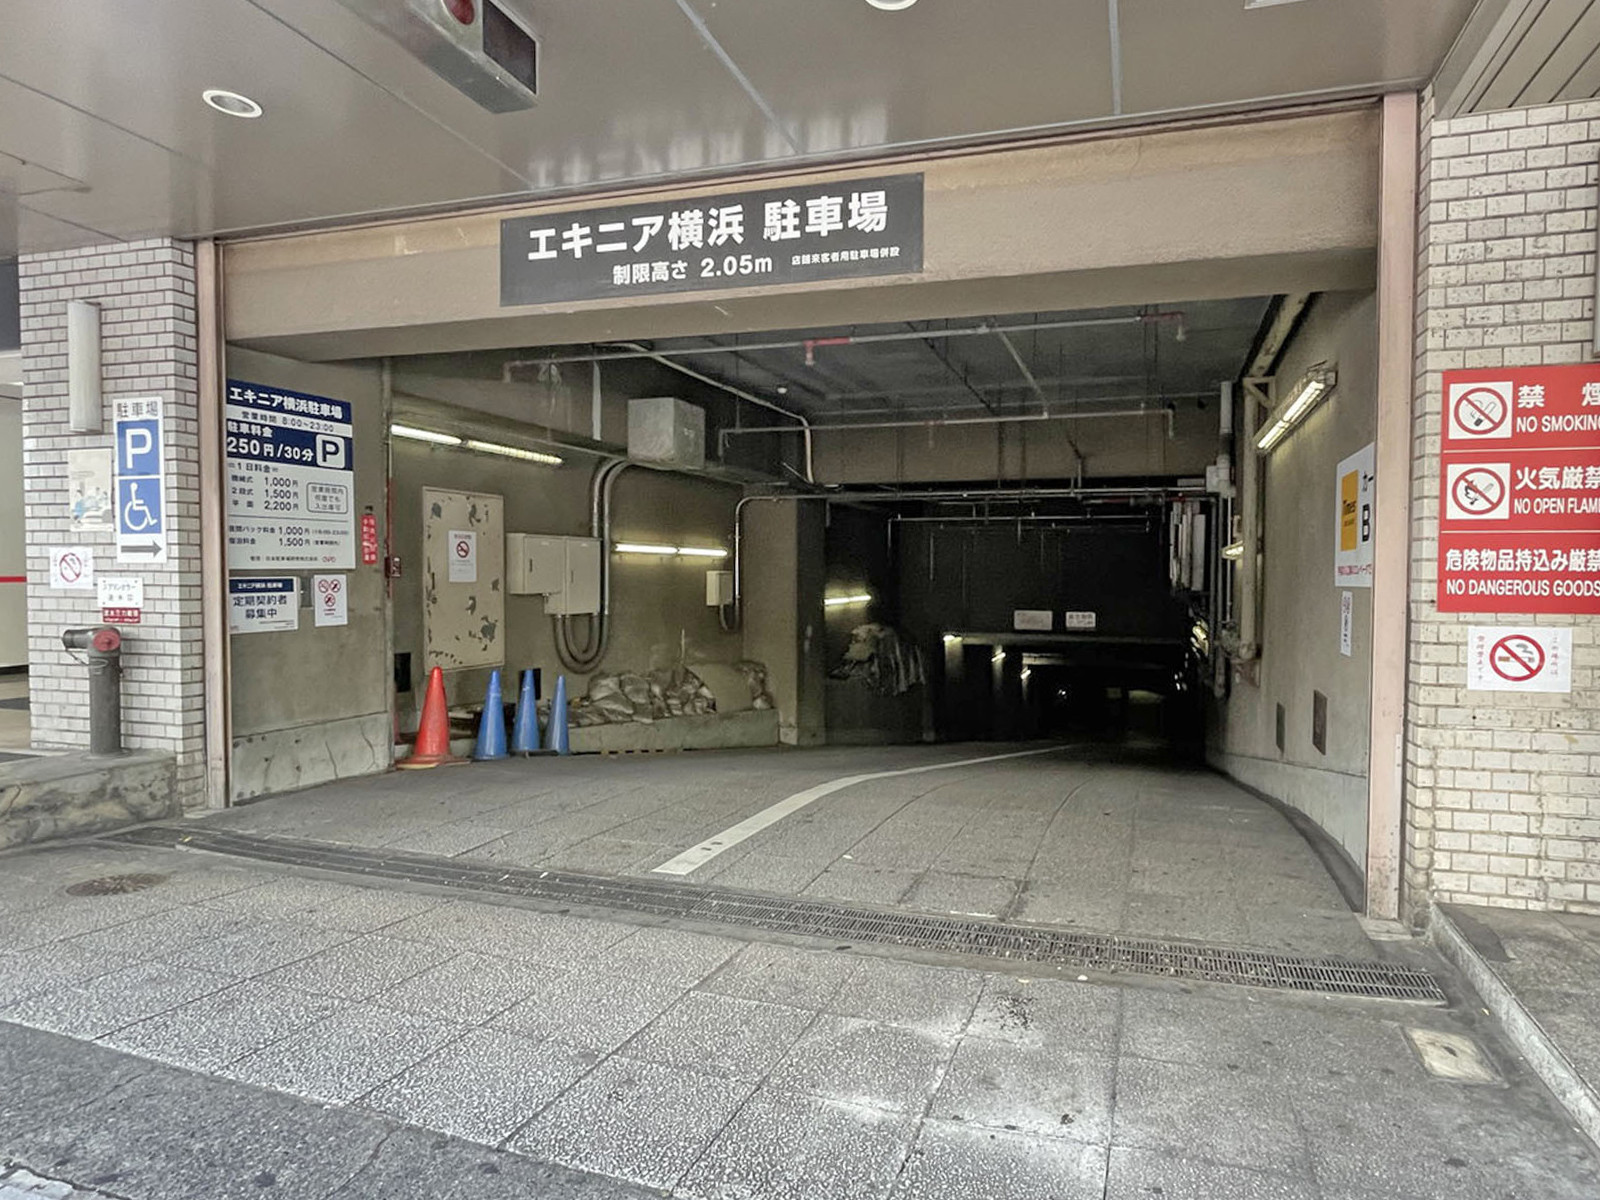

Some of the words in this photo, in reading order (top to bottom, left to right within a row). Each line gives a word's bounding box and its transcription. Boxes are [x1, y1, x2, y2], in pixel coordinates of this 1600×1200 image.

[528, 205, 744, 261] エキニア横浜
[763, 190, 888, 241] 駐車場
[613, 259, 687, 285] 制限高さ
[700, 255, 772, 279] 2.05m
[117, 402, 158, 419] 駐車場
[229, 387, 343, 420] エキニア横浜駐車場
[227, 421, 273, 438] 駐車料金
[1516, 416, 1538, 433] NO
[1541, 414, 1600, 432] SMOKIN
[1515, 466, 1600, 490] 火気厳禁
[1514, 498, 1531, 514] NO
[1533, 498, 1565, 514] OPEN
[1446, 549, 1600, 572] 危険物品持込み厳禁
[1447, 579, 1465, 595] NO
[1469, 579, 1549, 596] DANGEROUS
[1553, 580, 1600, 597] GOODS
[233, 594, 288, 607] 定期契約者
[245, 608, 277, 620] 募集中
